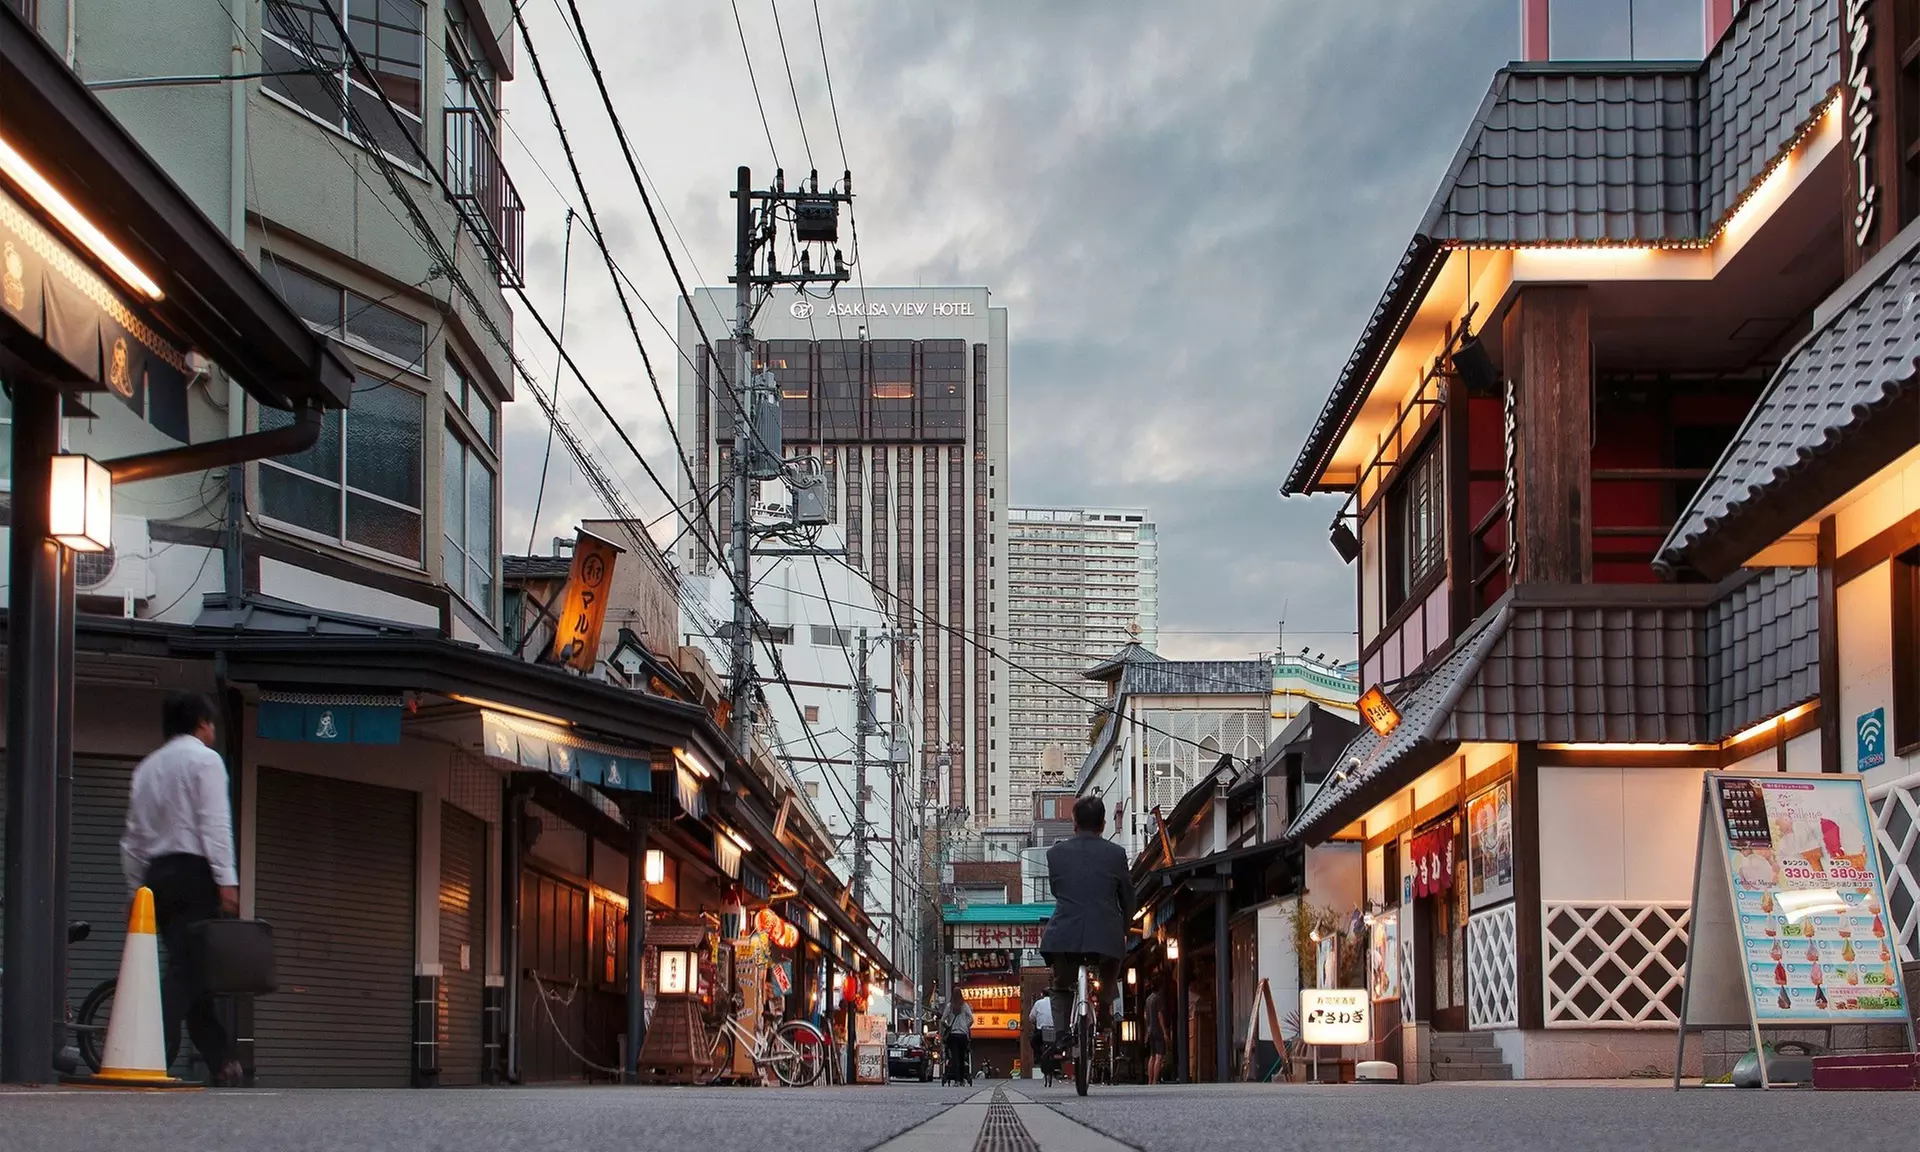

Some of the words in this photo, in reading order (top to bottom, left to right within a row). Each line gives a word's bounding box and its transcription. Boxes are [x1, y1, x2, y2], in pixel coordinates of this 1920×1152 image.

[826, 302, 888, 316] ASAKUSA
[891, 302, 929, 316] VIEW
[932, 302, 974, 316] HOTEL
[1784, 868, 1828, 879] 330yen
[1830, 868, 1875, 879] 380yen
[975, 927, 1044, 945] 花やしき通
[1325, 1009, 1364, 1024] さわぎ
